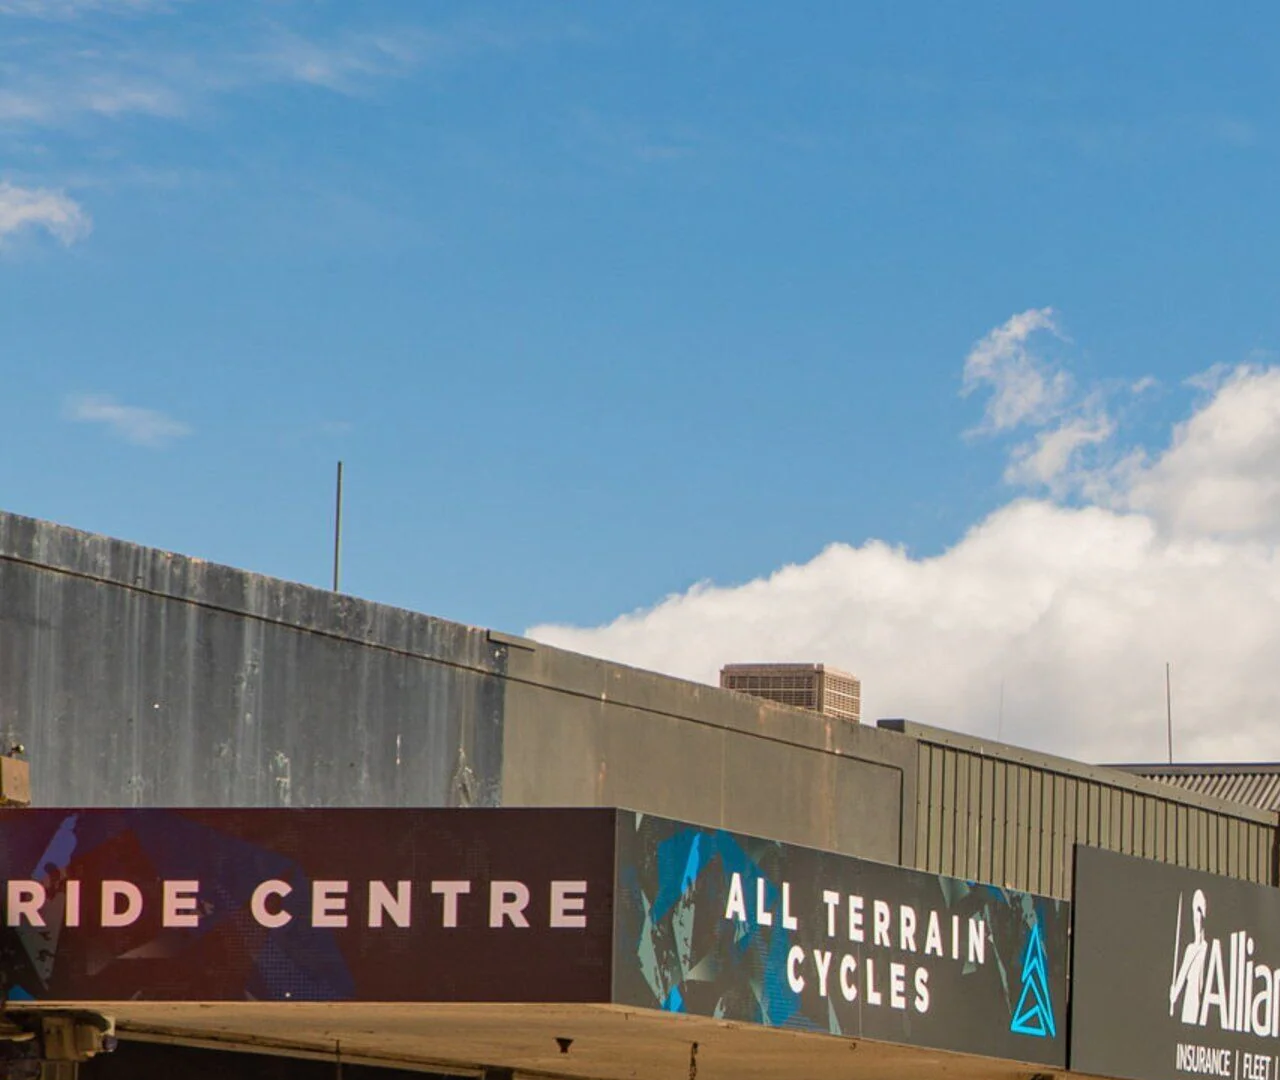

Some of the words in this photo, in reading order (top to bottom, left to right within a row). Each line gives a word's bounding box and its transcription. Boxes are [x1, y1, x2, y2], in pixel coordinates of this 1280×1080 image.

[7, 879, 201, 928] RIDE
[251, 878, 588, 928] CENTRE
[725, 872, 799, 931] ALL
[823, 890, 987, 965] TERRAIN
[787, 949, 930, 1013] CYCLES
[1176, 1043, 1230, 1078] INSURANCE
